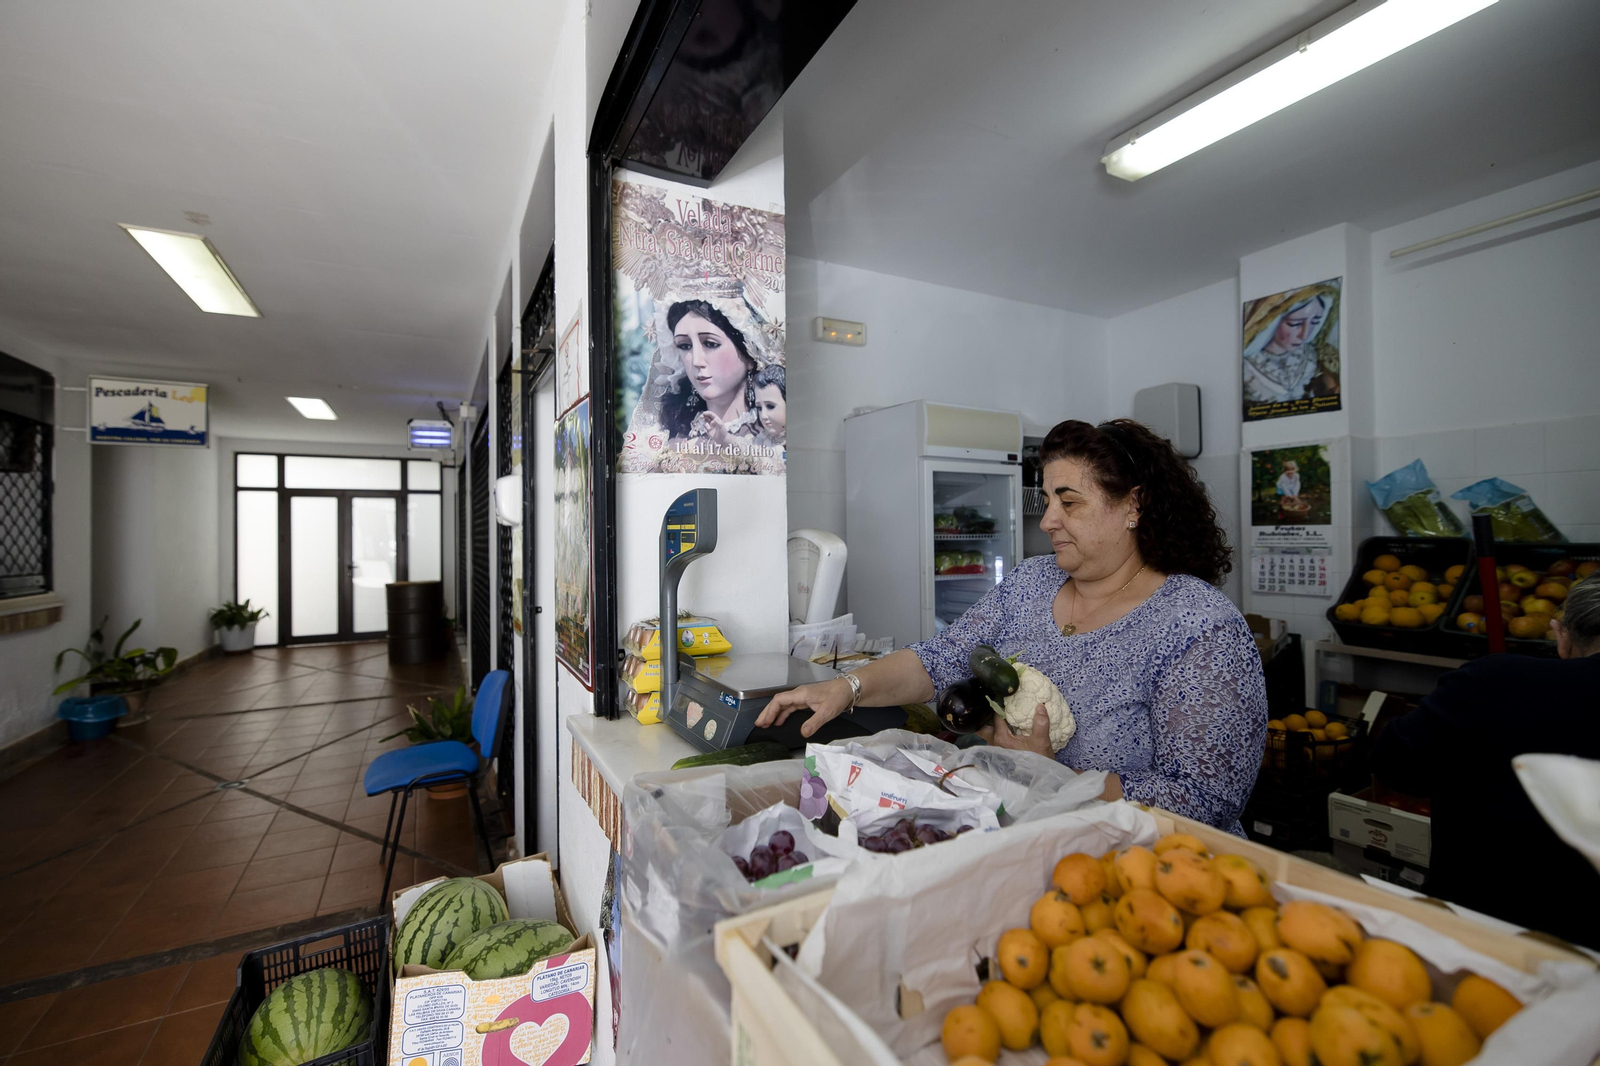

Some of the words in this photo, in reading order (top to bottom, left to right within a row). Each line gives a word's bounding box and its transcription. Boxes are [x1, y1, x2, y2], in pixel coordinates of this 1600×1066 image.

[676, 199, 732, 234] Velada
[618, 220, 662, 254] Ntra.
[666, 230, 698, 260] Sra.
[702, 236, 726, 264] del
[674, 442, 689, 454] 14
[693, 442, 705, 455] al
[708, 444, 722, 455] 17
[725, 444, 740, 456] de
[744, 444, 774, 458] Julio
[881, 792, 907, 804] unifrutti
[564, 965, 585, 974] CANARIAS
